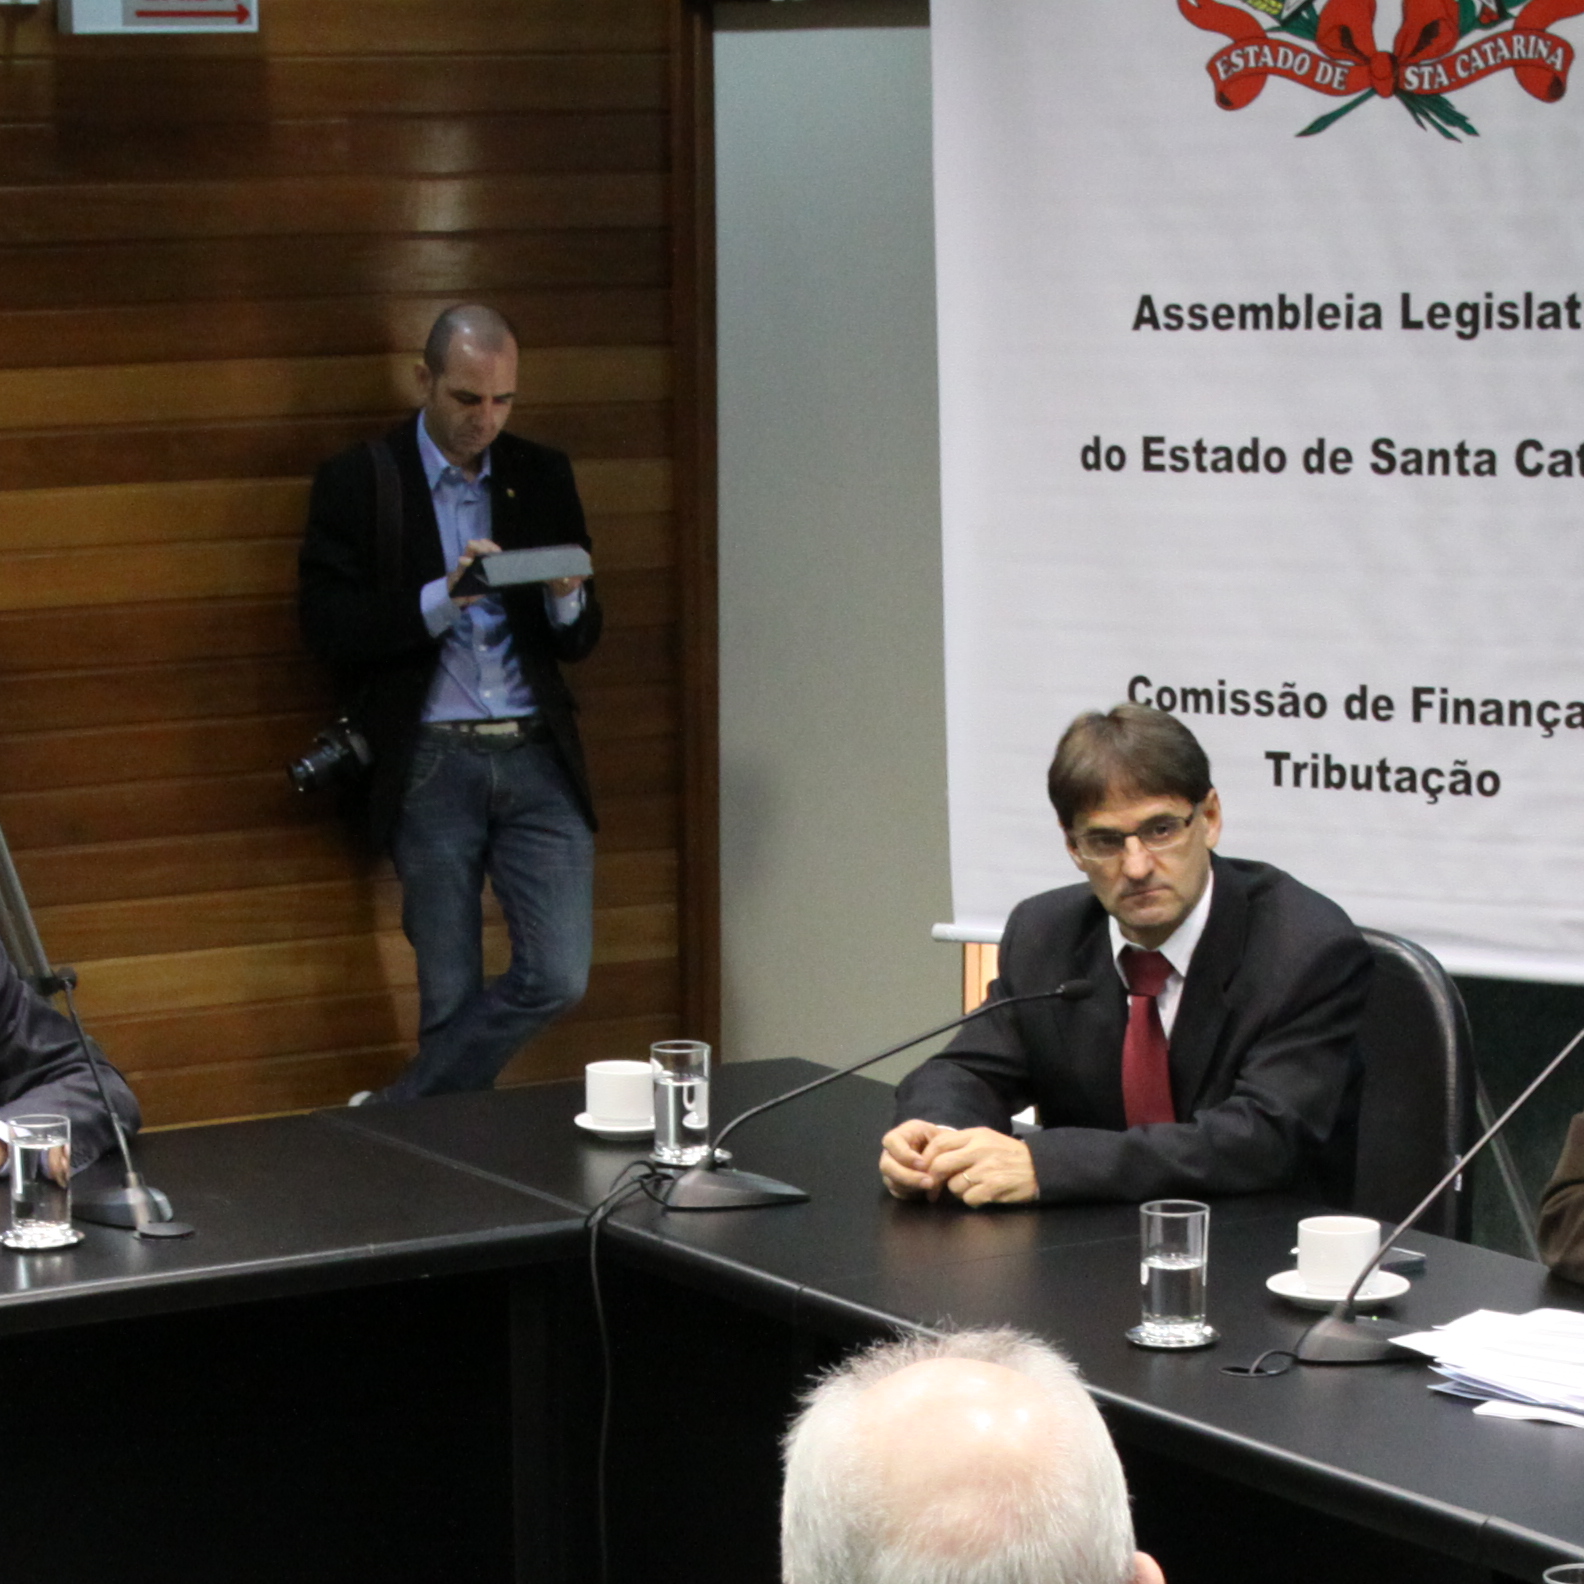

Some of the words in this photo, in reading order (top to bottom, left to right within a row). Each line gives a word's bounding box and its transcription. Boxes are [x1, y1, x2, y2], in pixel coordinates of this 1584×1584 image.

[1216, 45, 1311, 81] ESTADO
[1314, 61, 1349, 91] DE
[1404, 64, 1456, 91] STA.
[1455, 34, 1565, 79] CATARINA
[1133, 293, 1381, 330] Assembleia
[1082, 436, 1125, 471] do
[1143, 437, 1286, 473] Estado
[1304, 438, 1352, 474] de
[1371, 438, 1496, 476] Santa
[1128, 674, 1328, 720] Comissão
[1345, 685, 1393, 721] de
[1266, 752, 1500, 803] Tributação
